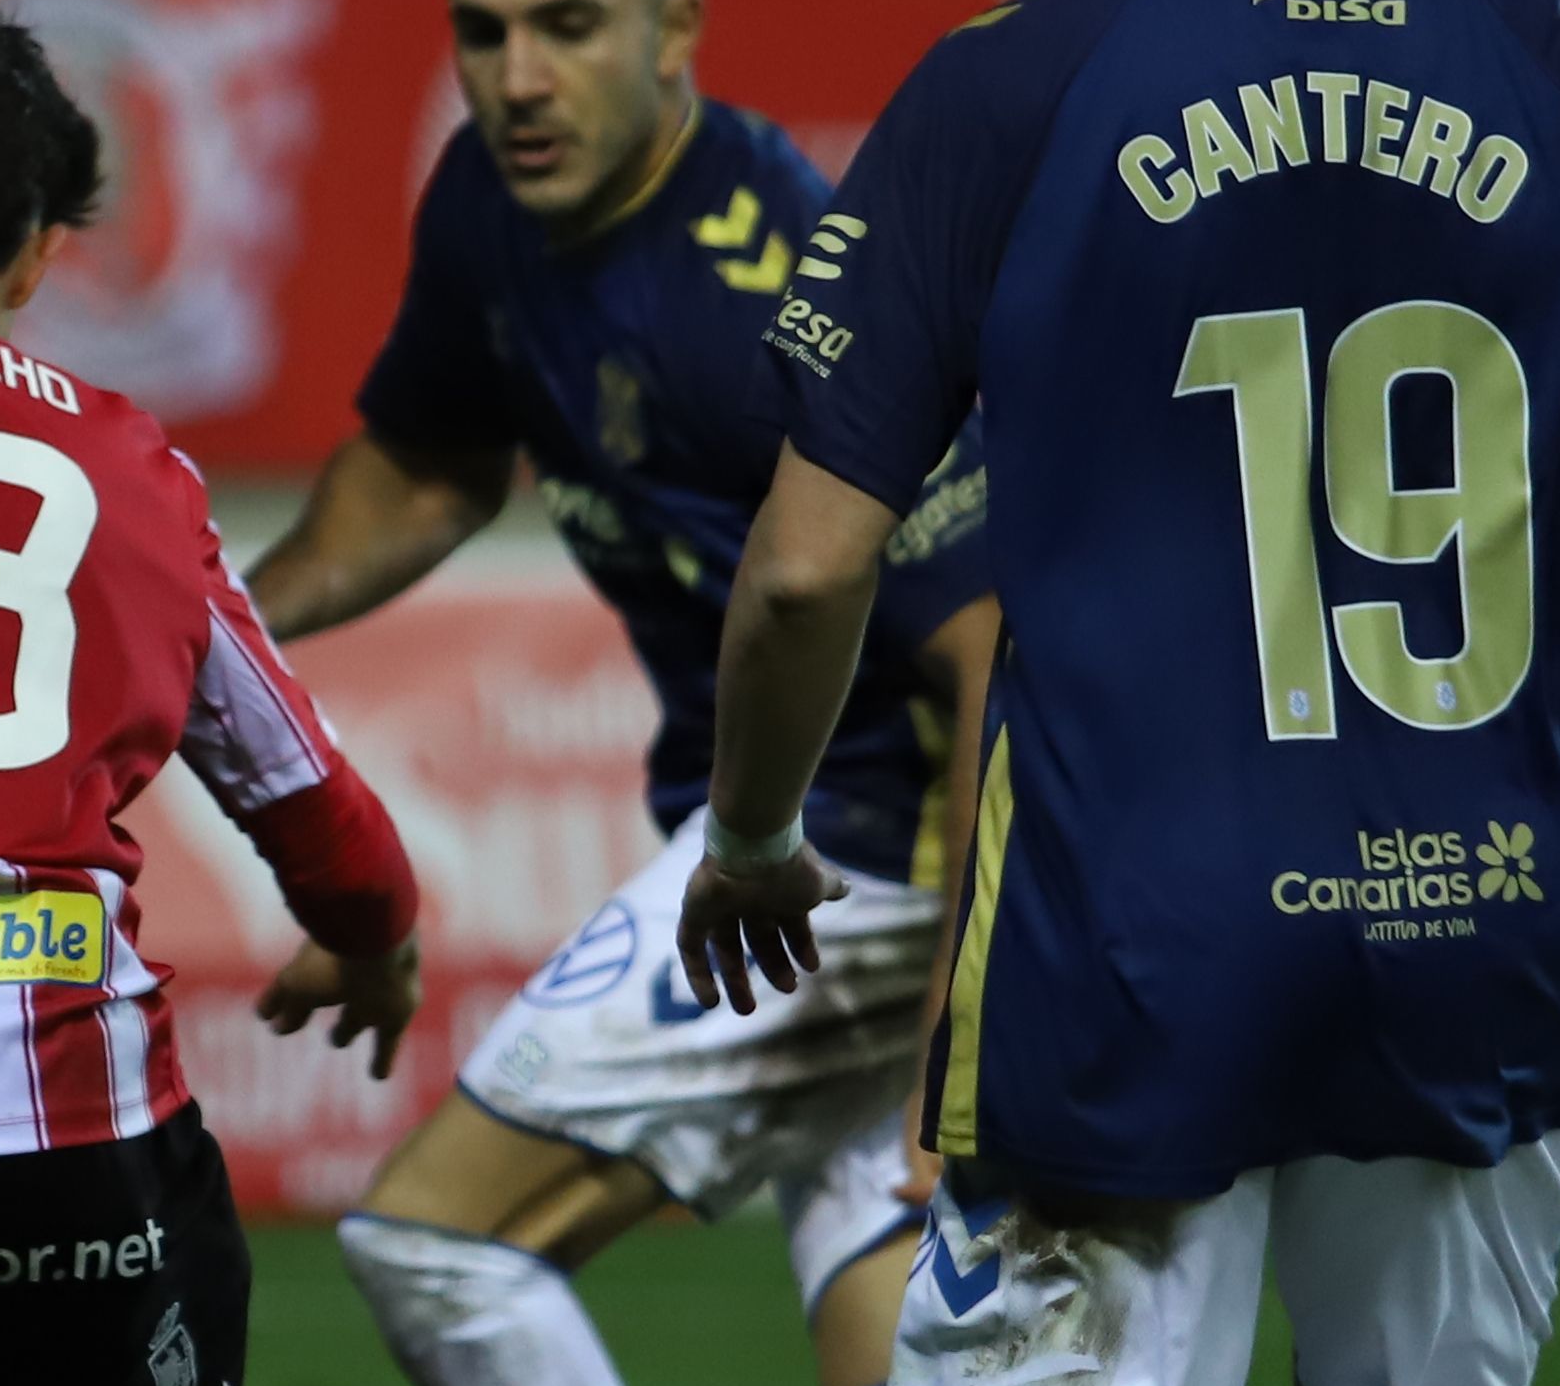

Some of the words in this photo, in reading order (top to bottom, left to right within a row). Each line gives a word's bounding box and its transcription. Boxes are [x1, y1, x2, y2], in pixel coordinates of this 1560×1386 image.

[1118, 70, 1530, 224] CANTERO
[1172, 299, 1535, 742] 19
[1356, 827, 1468, 872] Islas
[1269, 866, 1475, 915] Canarias
[1424, 917, 1444, 939] DE
[1447, 916, 1477, 938] VIDA
